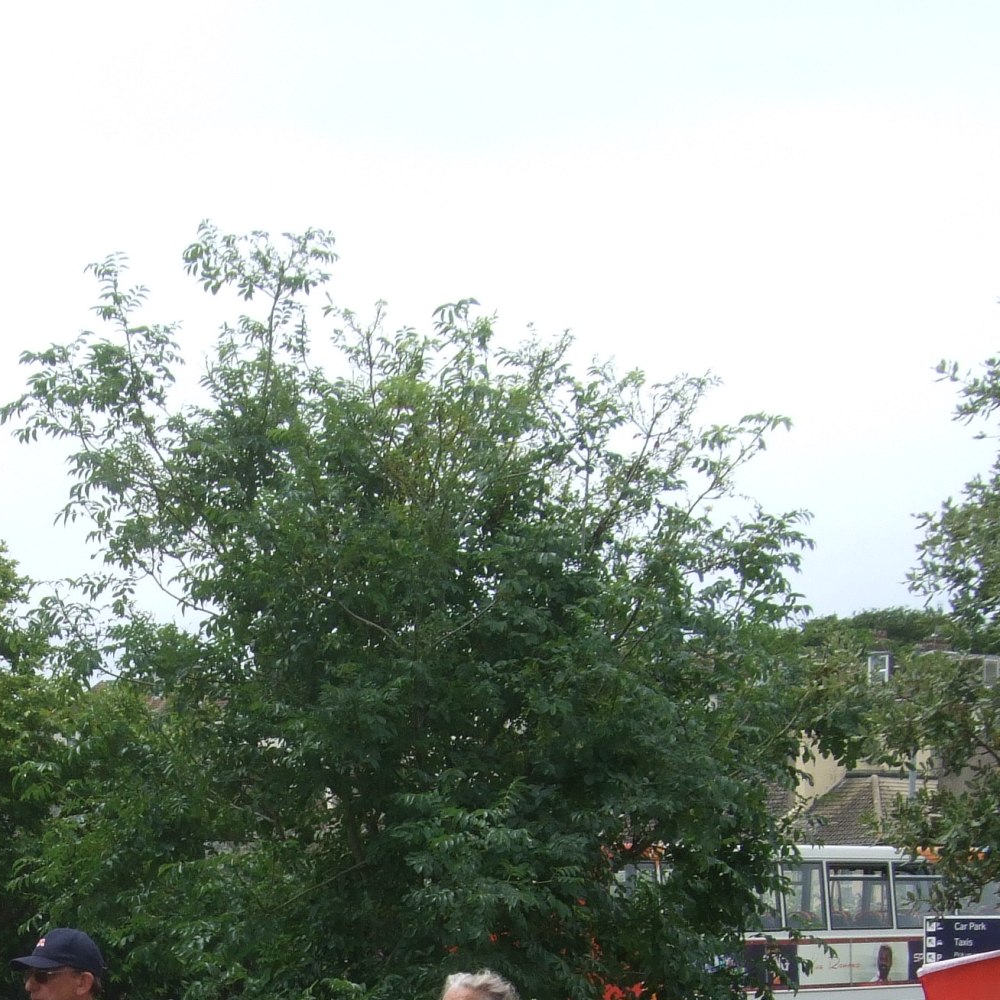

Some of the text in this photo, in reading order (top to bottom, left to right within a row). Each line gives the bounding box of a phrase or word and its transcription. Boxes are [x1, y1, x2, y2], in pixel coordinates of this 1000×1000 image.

[954, 922, 987, 931] Car Park
[953, 937, 974, 947] Taxis
